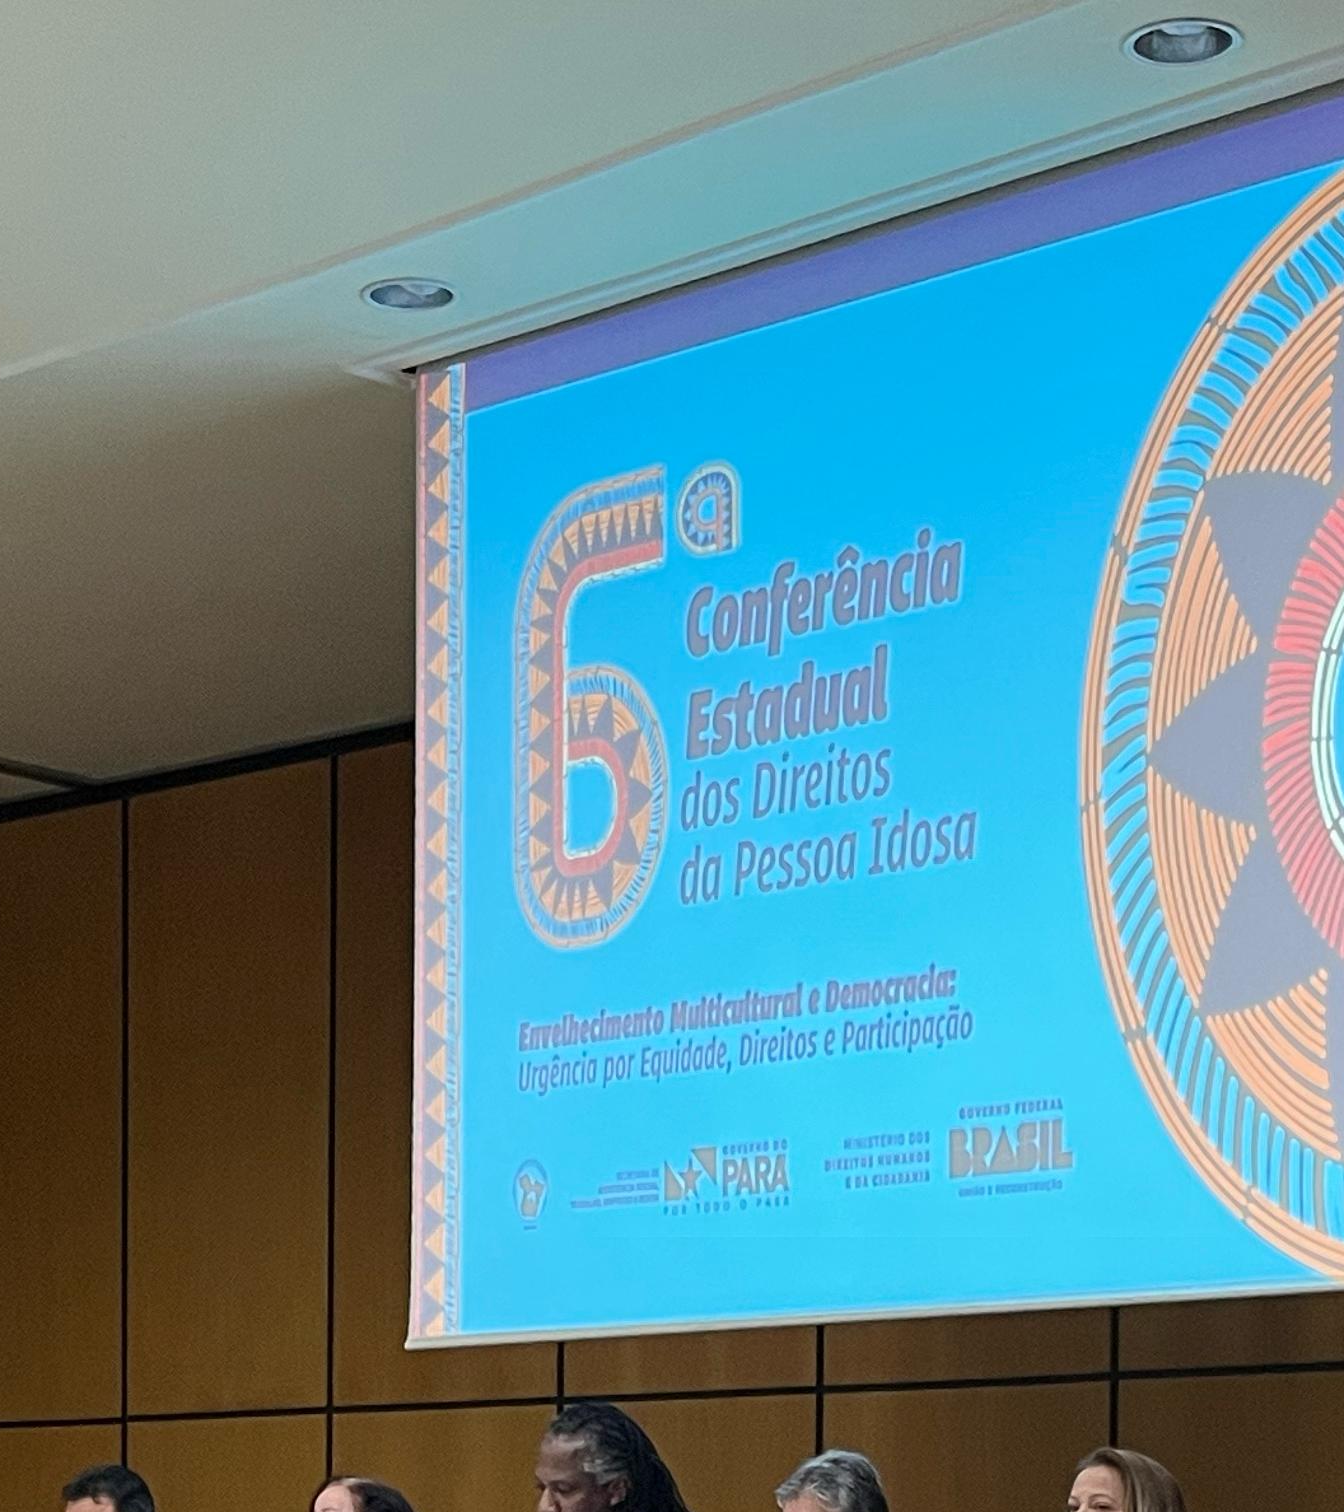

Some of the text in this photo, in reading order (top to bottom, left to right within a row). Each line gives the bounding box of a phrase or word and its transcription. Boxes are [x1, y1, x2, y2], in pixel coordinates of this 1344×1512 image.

[686, 527, 962, 658] Conferência
[686, 644, 888, 759] Estadual
[680, 742, 892, 832] dos Direitos
[680, 808, 977, 905] da Pessoa Idosa
[518, 961, 958, 1052] Envelhecimento Multicultural e Democracia:
[518, 1003, 974, 1097] Urgência por Equidade, Direitos e Participação
[949, 1117, 1074, 1180] BRASIL
